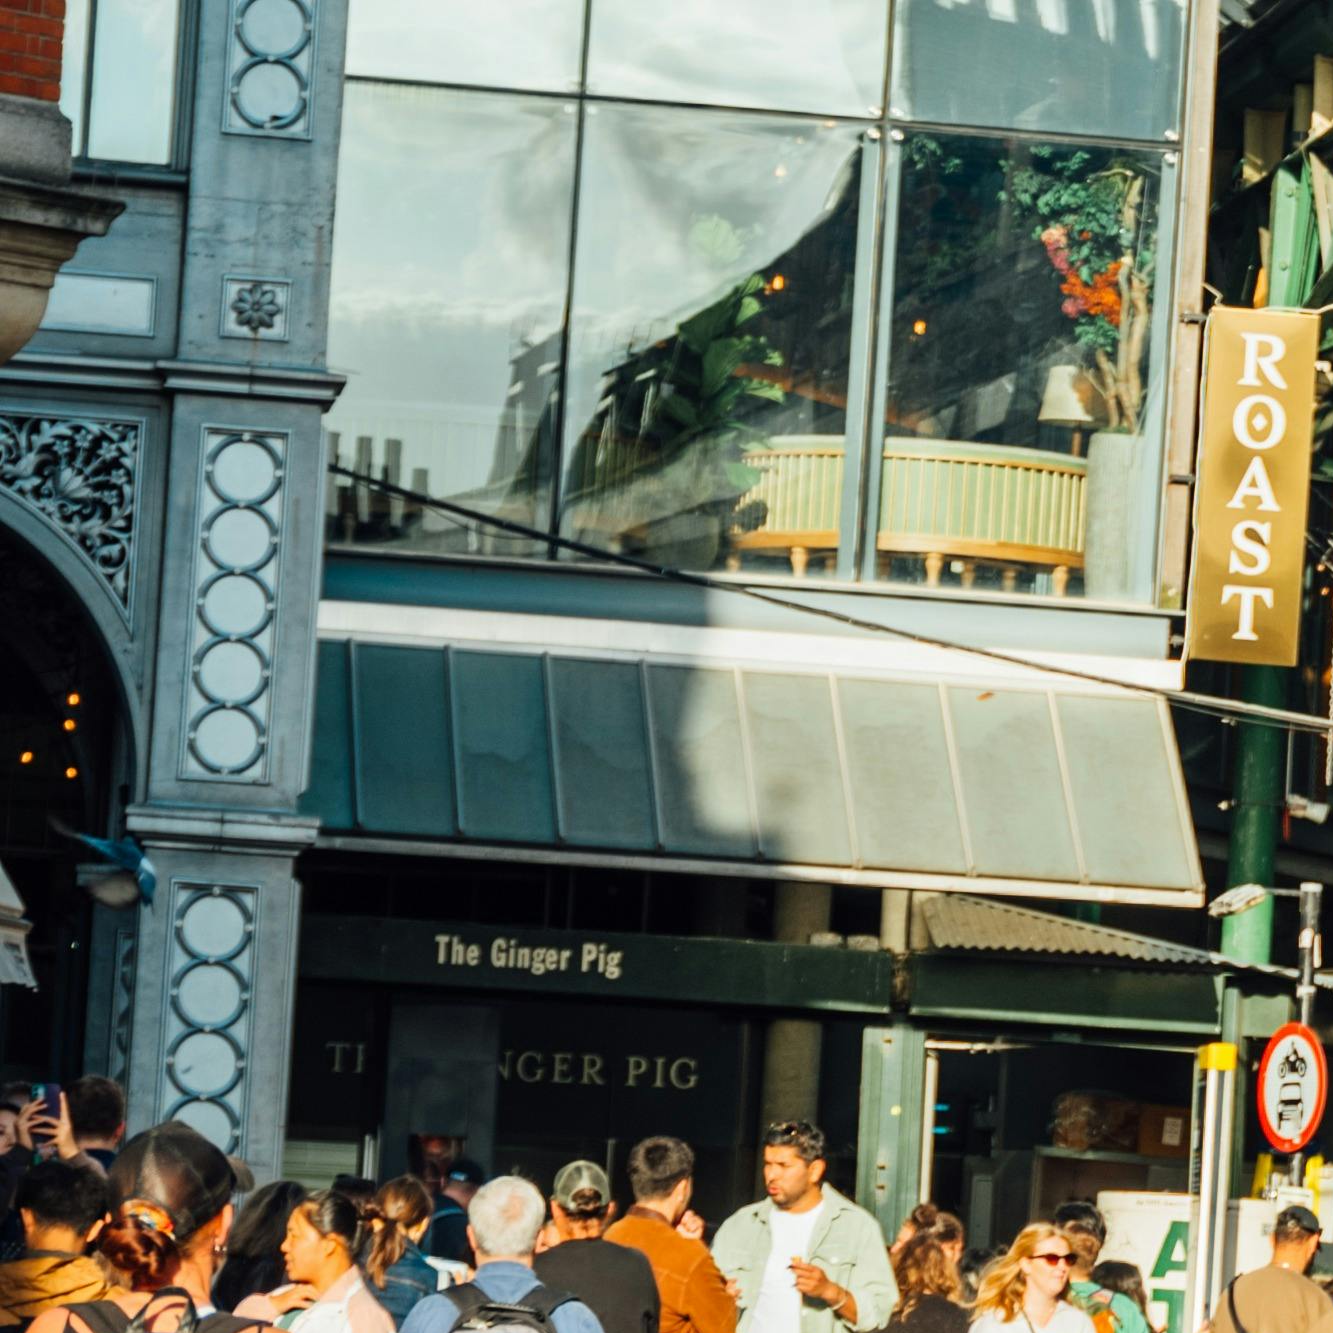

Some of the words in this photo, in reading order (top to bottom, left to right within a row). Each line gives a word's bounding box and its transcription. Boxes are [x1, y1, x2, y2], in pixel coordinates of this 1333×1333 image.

[1221, 332, 1289, 641] ROAST
[435, 934, 481, 967] The
[491, 938, 573, 976] Ginger
[581, 943, 623, 981] Pig
[625, 1056, 699, 1091] PIG
